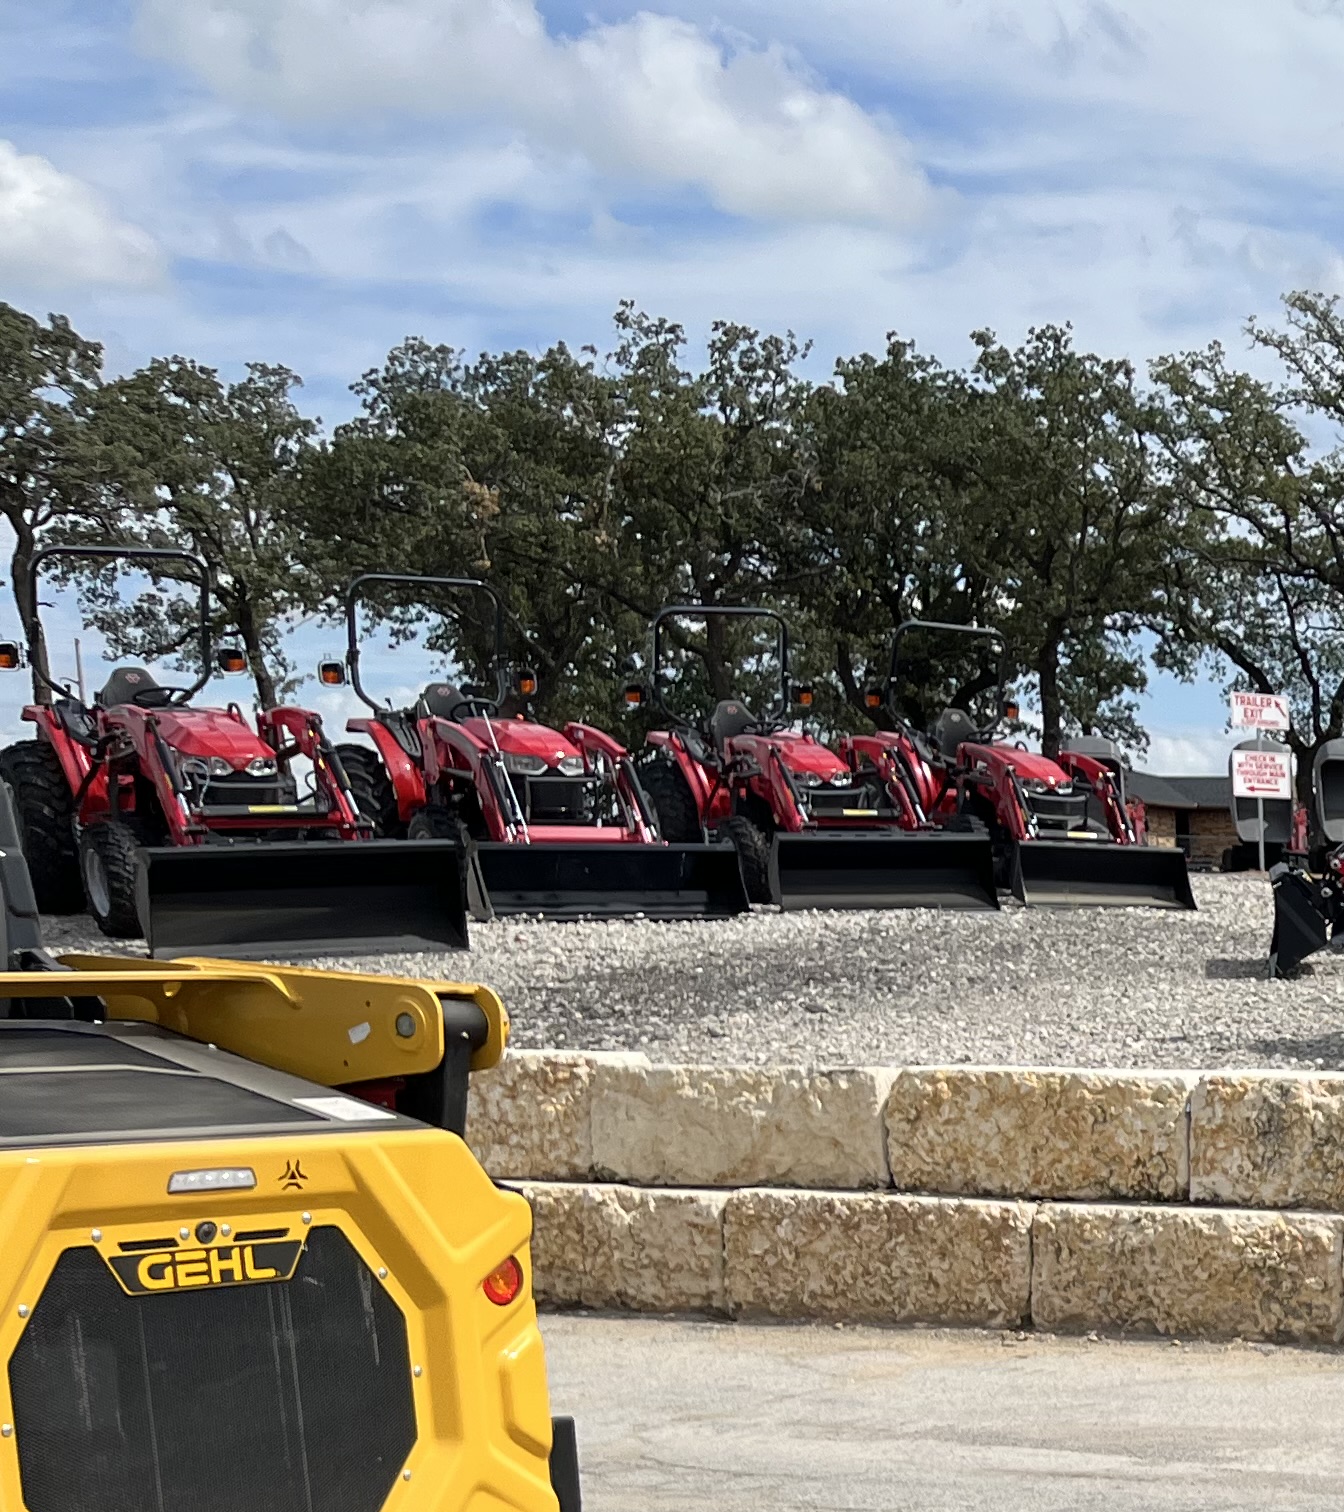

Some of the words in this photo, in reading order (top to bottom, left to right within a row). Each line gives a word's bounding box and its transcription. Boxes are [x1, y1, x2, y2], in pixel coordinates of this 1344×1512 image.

[1235, 695, 1272, 708] TRAILER
[1243, 707, 1263, 719] EXIT
[137, 1244, 277, 1290] GEHL
